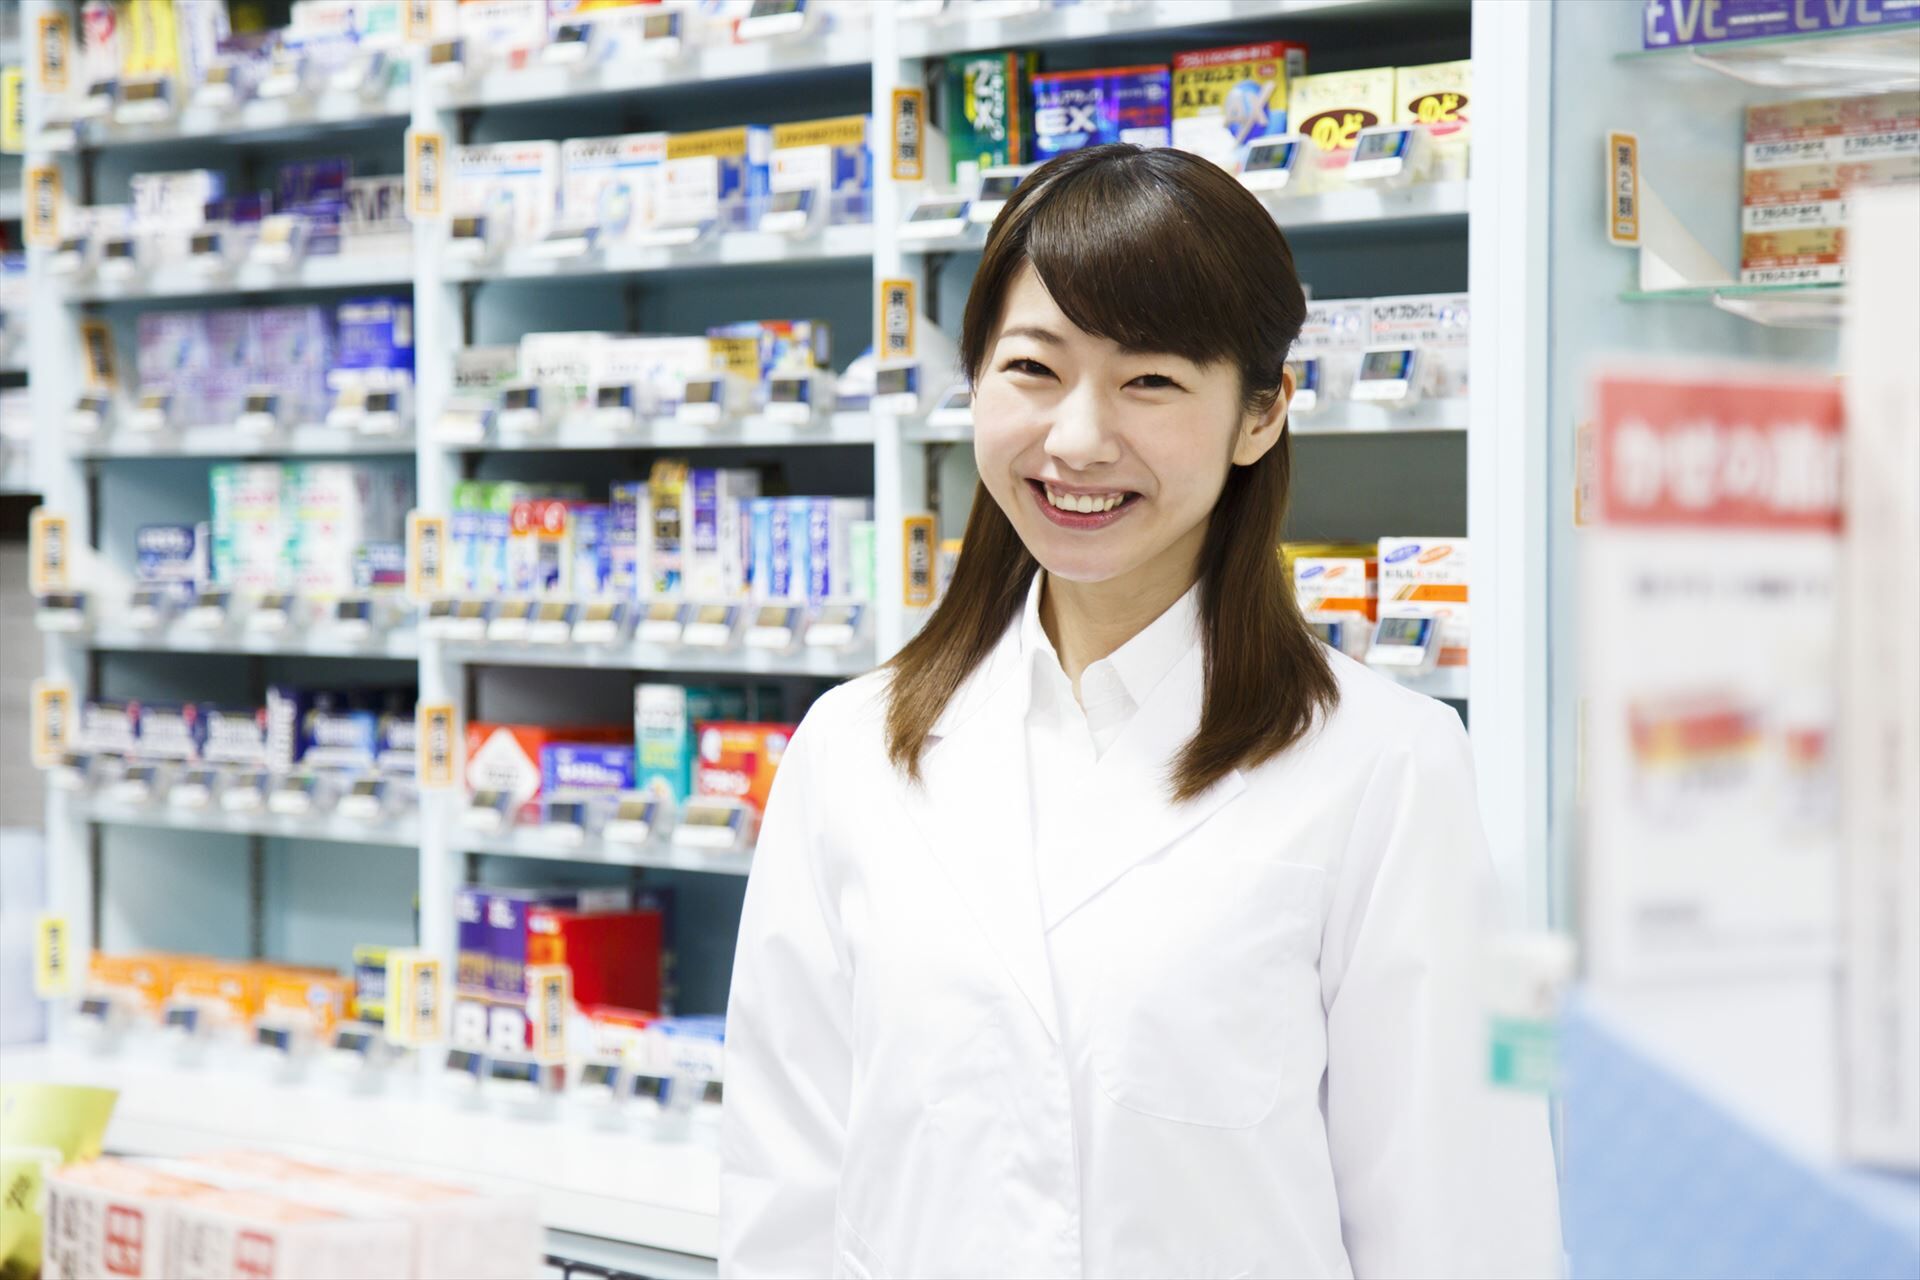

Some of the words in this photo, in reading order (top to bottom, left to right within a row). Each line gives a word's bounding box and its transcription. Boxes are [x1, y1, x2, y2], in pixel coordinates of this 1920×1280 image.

[1034, 104, 1097, 138] EX
[1418, 92, 1460, 124] のど
[1311, 112, 1365, 151] のど
